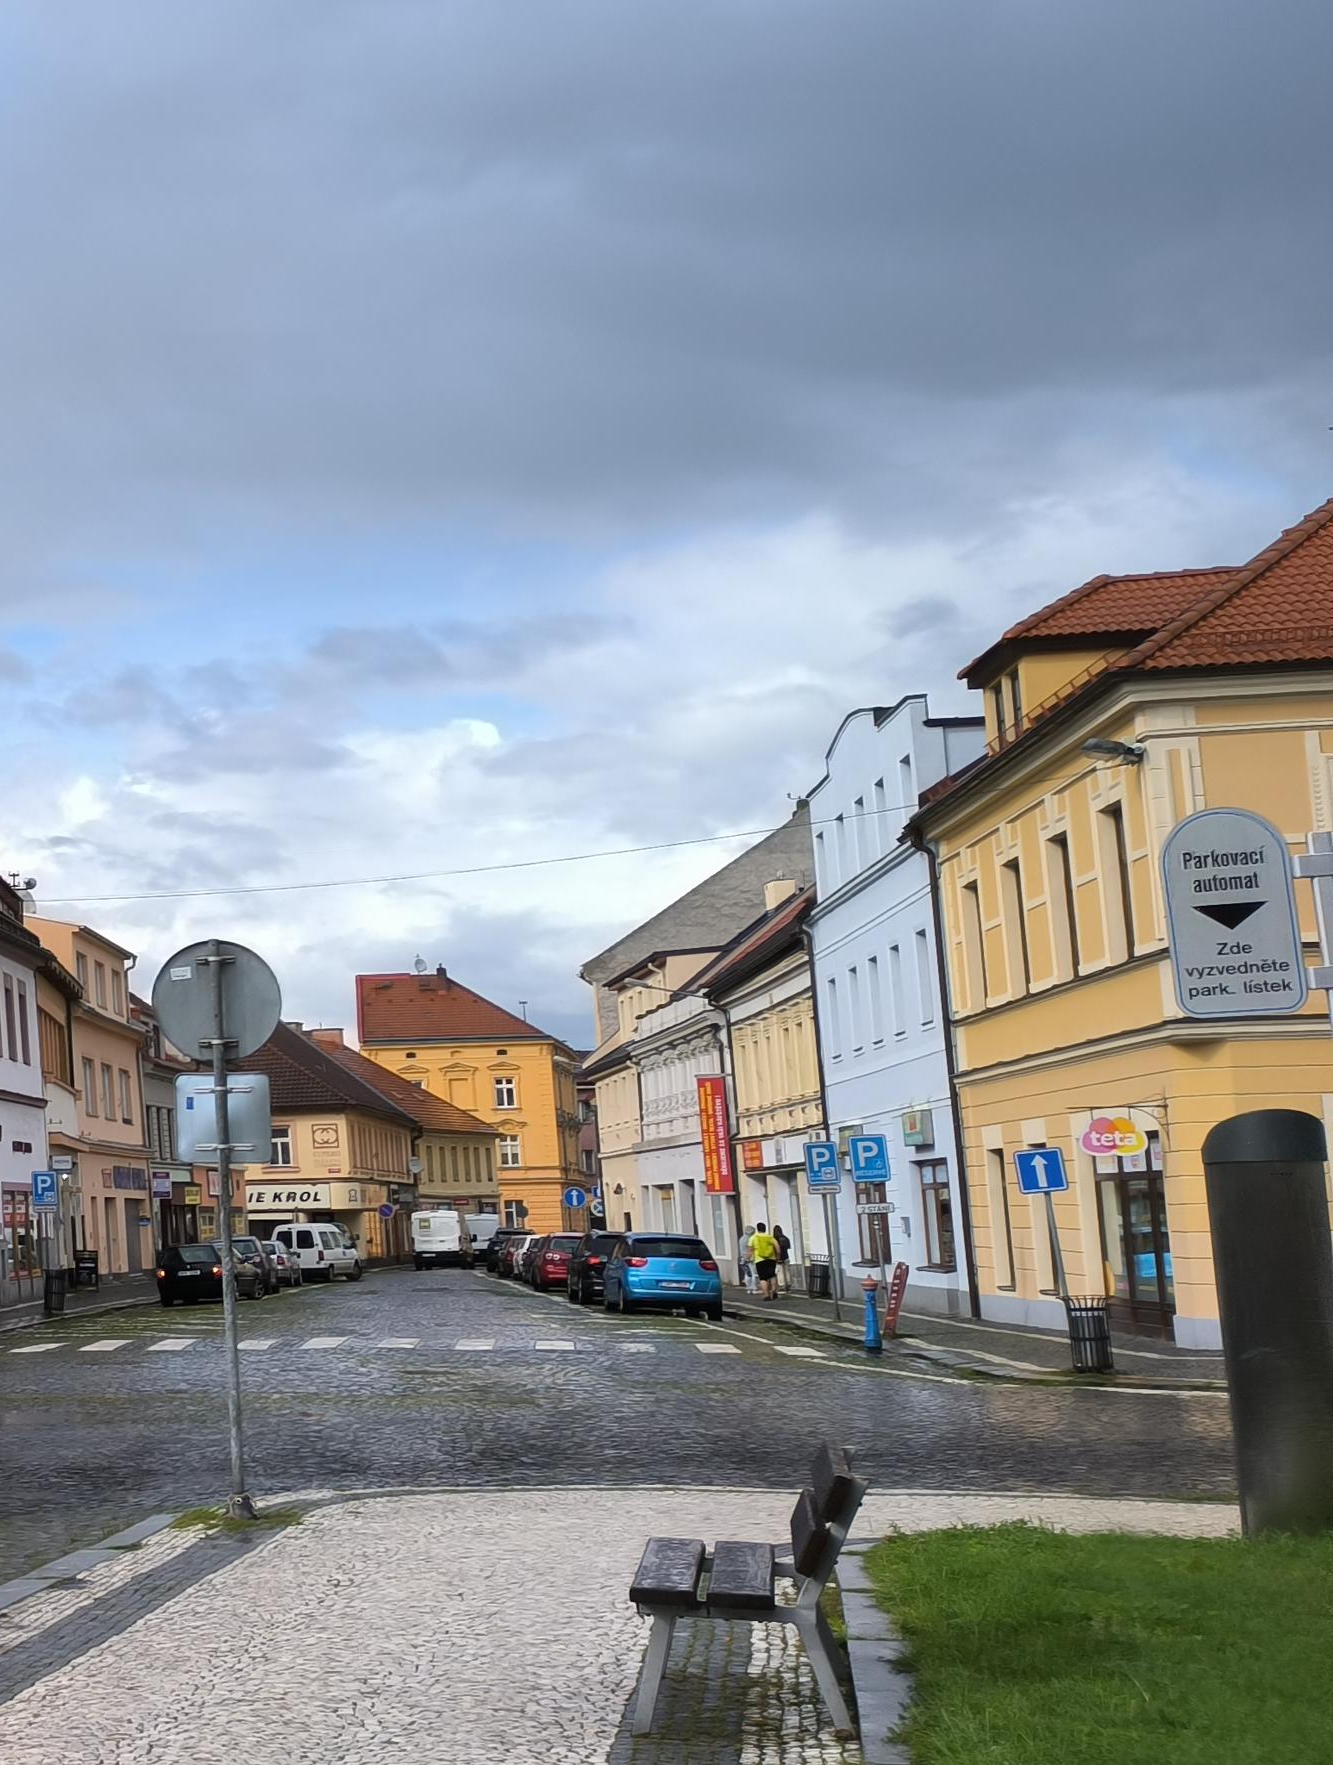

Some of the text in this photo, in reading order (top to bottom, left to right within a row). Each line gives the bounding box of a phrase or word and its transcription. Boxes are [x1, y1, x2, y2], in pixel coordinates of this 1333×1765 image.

[1181, 844, 1266, 870] Parkovací
[1192, 871, 1260, 893] automat
[1216, 941, 1253, 956] Zde
[1185, 959, 1290, 980] vyzvedněte
[1243, 978, 1294, 994] lístek
[1089, 1130, 1137, 1146] teta
[810, 1147, 831, 1172] P
[856, 1140, 879, 1168] P
[36, 1175, 52, 1195] P
[271, 1190, 323, 1204] KROL
